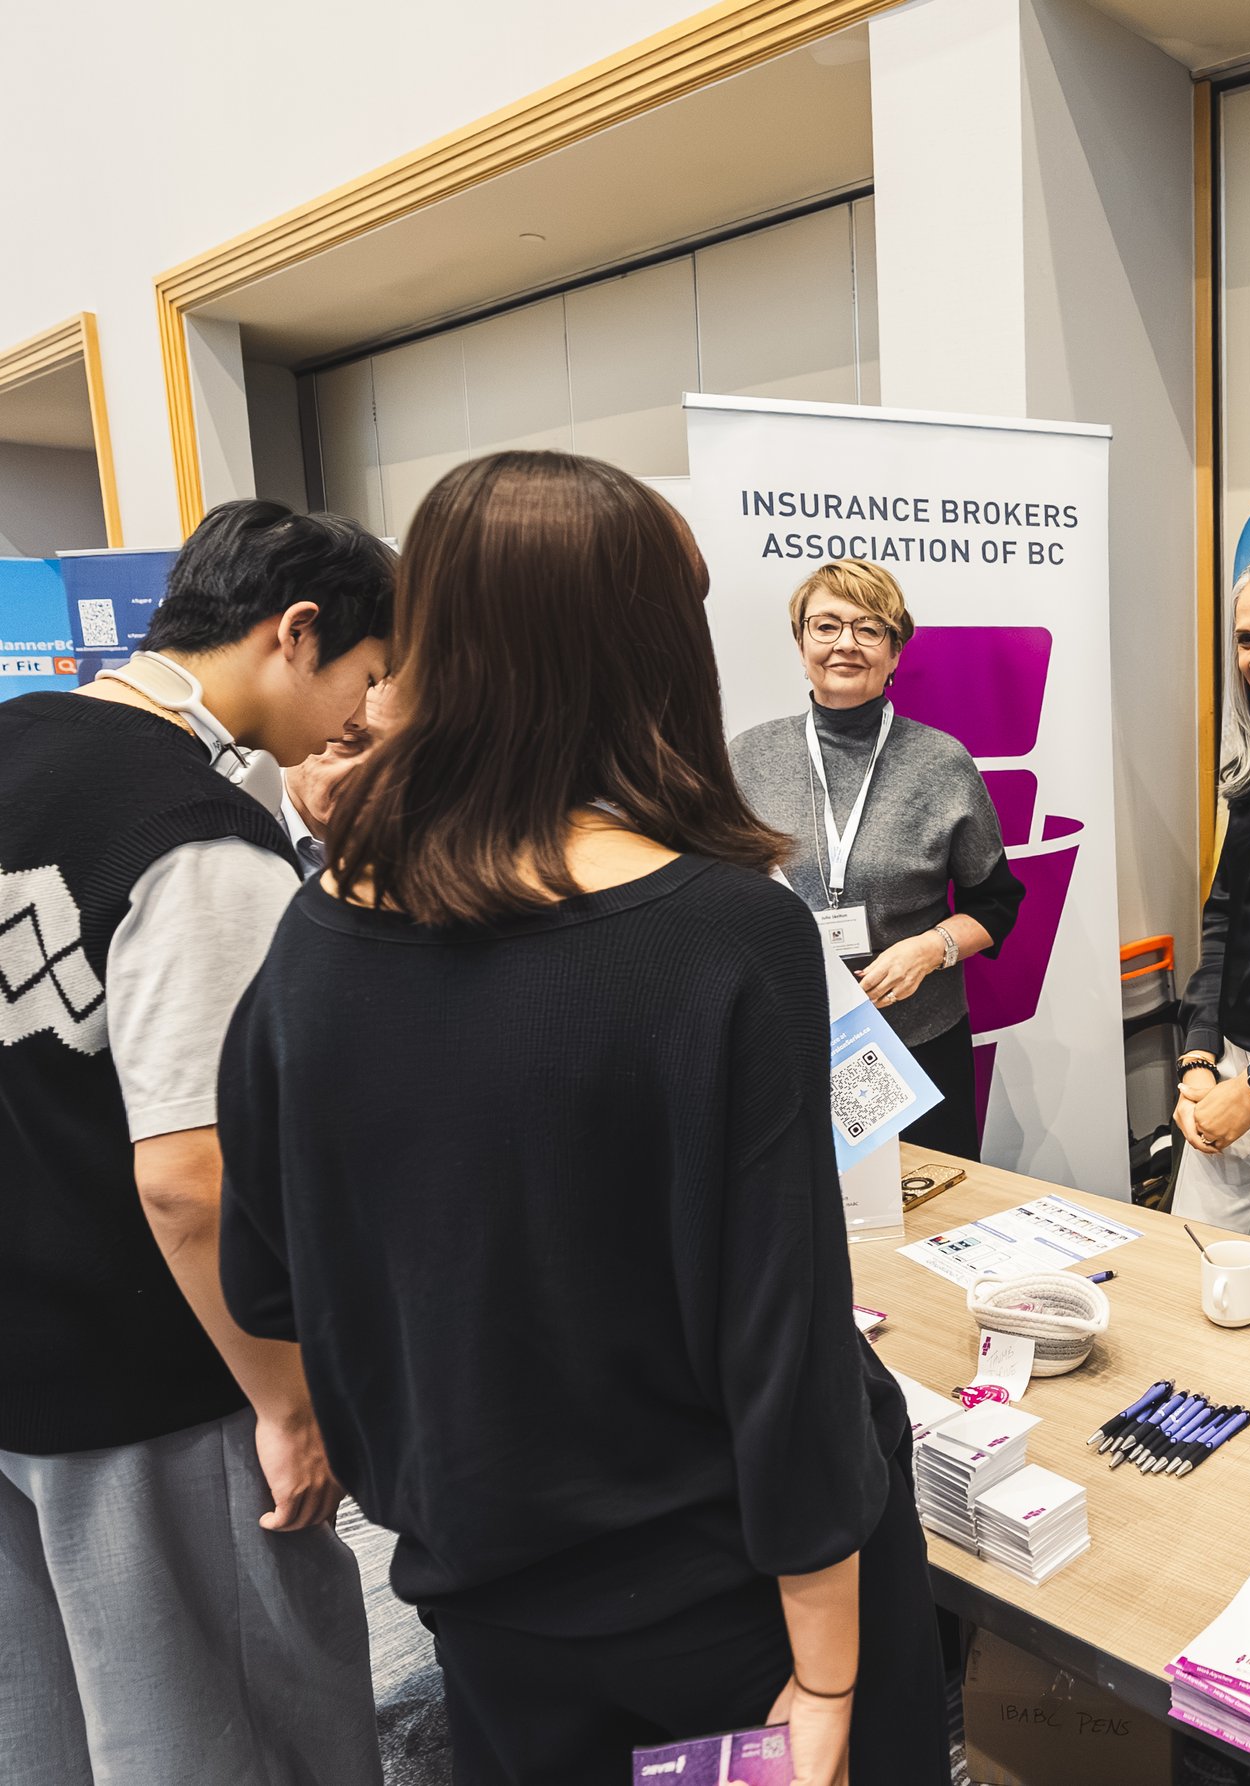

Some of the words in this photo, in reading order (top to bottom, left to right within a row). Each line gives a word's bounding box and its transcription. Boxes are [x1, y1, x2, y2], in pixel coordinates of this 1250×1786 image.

[742, 490, 930, 523] INSURANCE
[942, 499, 1079, 528] BROKERS
[762, 532, 970, 563] ASSOCIATION
[982, 540, 1017, 564] OF
[1028, 541, 1065, 566] BC
[17, 661, 41, 672] Fit
[1001, 1704, 1062, 1727] IBABC
[1076, 1711, 1132, 1737] PENS
